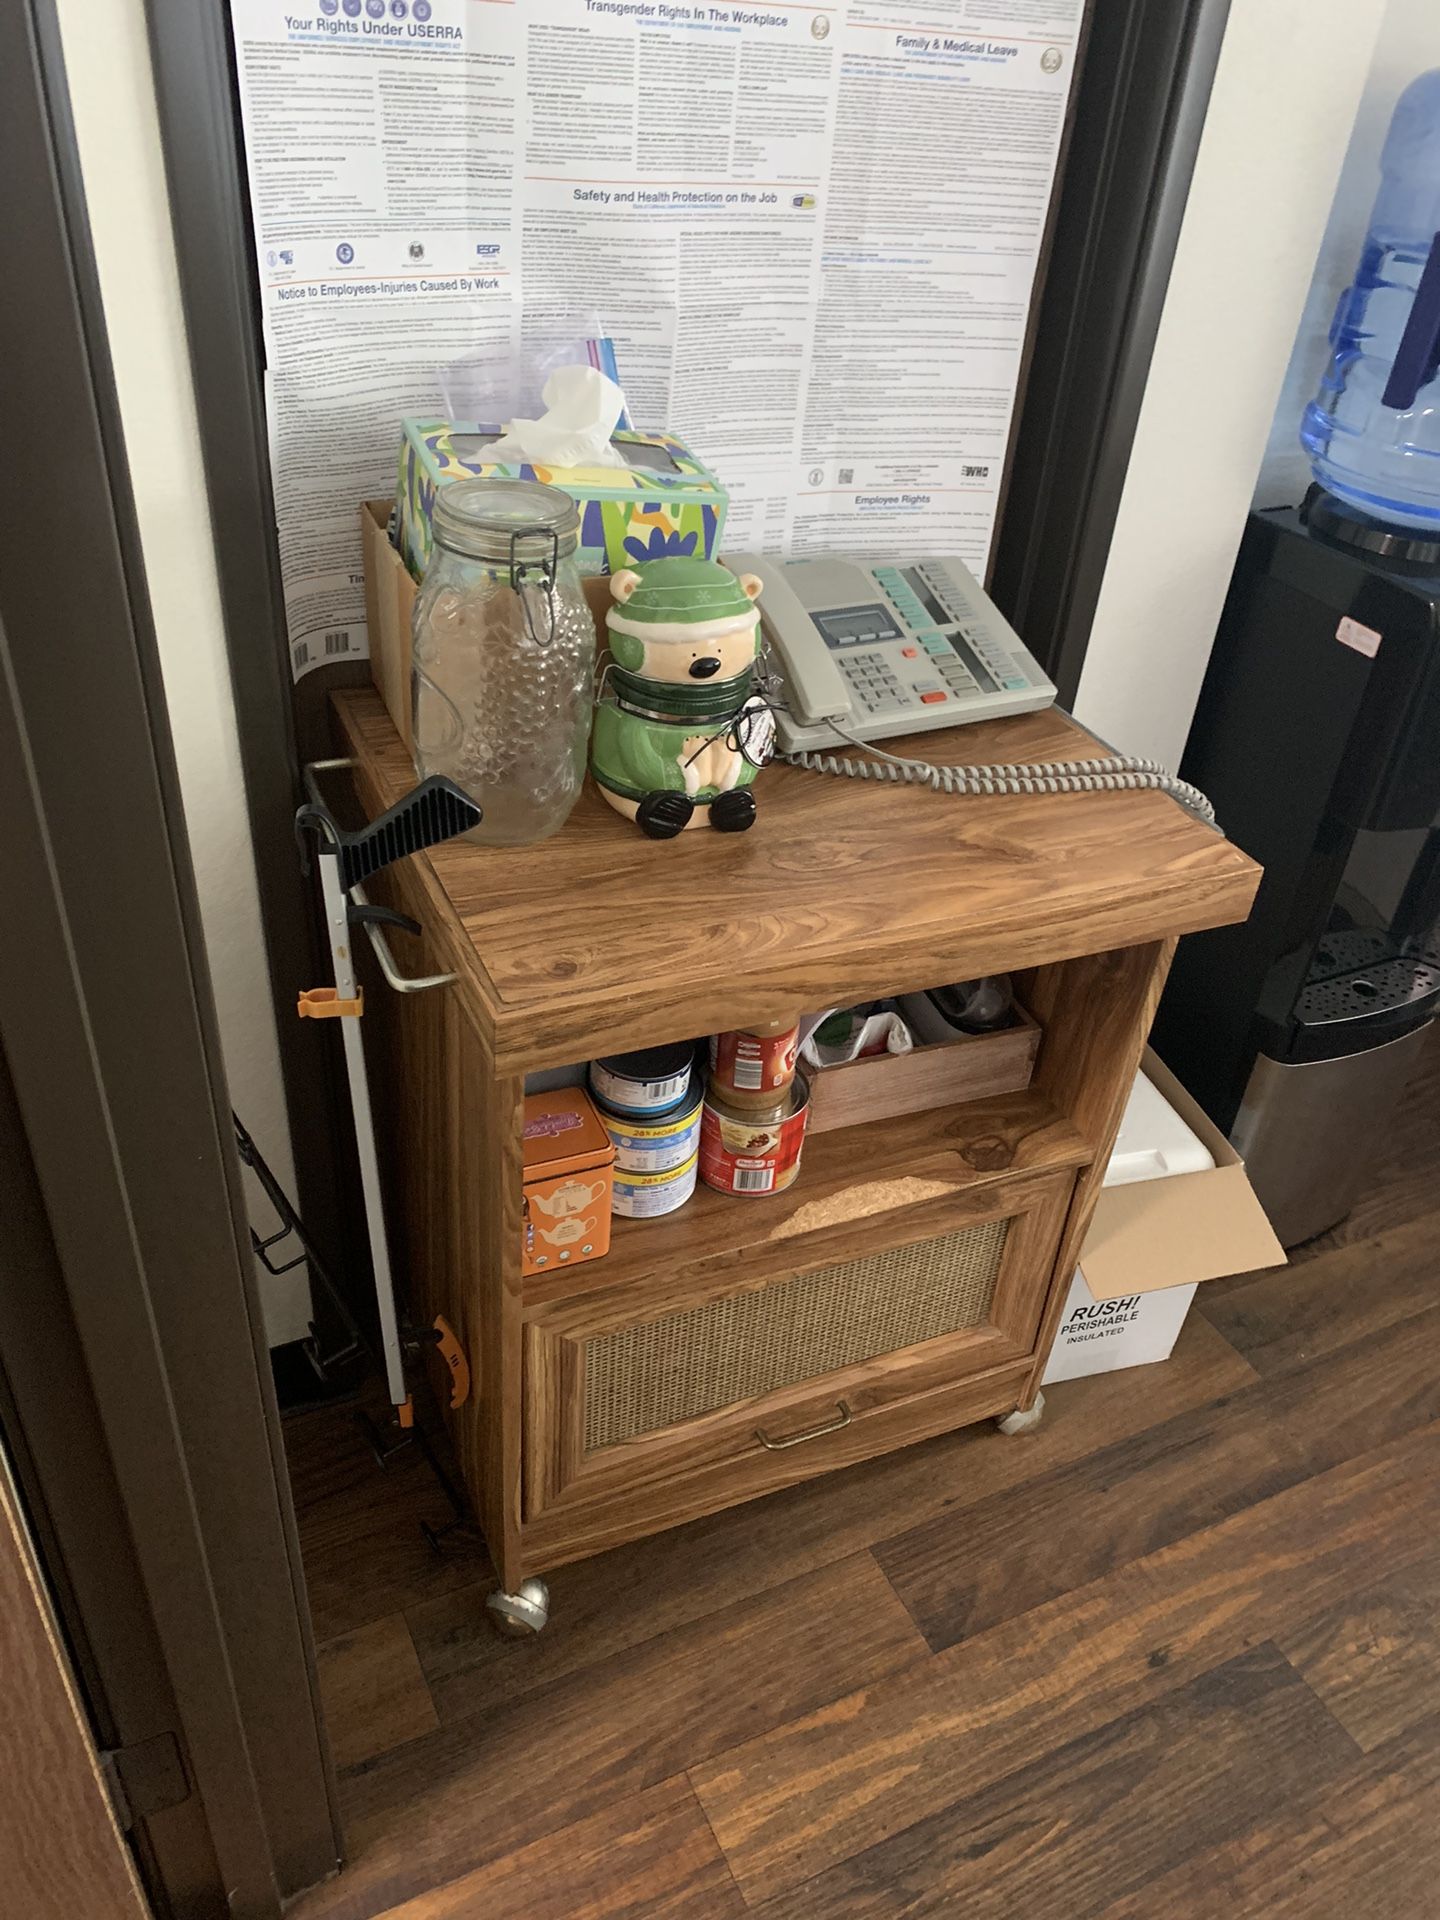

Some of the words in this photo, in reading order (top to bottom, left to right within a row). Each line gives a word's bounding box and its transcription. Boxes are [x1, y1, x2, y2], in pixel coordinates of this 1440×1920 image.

[584, 0, 656, 16] Transgender
[658, 4, 691, 20] Rights
[694, 7, 705, 19] In
[708, 8, 729, 22] The
[732, 11, 788, 27] Workplace
[284, 16, 312, 30] Your
[317, 17, 358, 34] Rights
[363, 21, 403, 36] Under
[407, 24, 463, 40] USERRA
[896, 35, 930, 50] Family
[933, 38, 941, 49] &
[943, 39, 985, 54] Medical
[987, 43, 1018, 57] Leave
[573, 188, 611, 204] Safety
[614, 190, 635, 203] and
[637, 190, 670, 203] Health
[672, 191, 723, 203] Protection
[725, 194, 738, 203] on
[740, 192, 757, 204] the
[758, 192, 778, 204] Job
[277, 285, 306, 301] Notice
[307, 285, 318, 297] to
[320, 279, 418, 298] Employees-Injuries
[420, 278, 458, 292] Caused
[460, 278, 473, 291] By
[474, 277, 499, 290] Work
[855, 495, 899, 505] Employee
[901, 494, 931, 505] Rights
[1070, 1295, 1141, 1323] RUSH!
[1060, 1310, 1140, 1336] PERISHABLE
[1066, 1327, 1125, 1345] INSULATED
